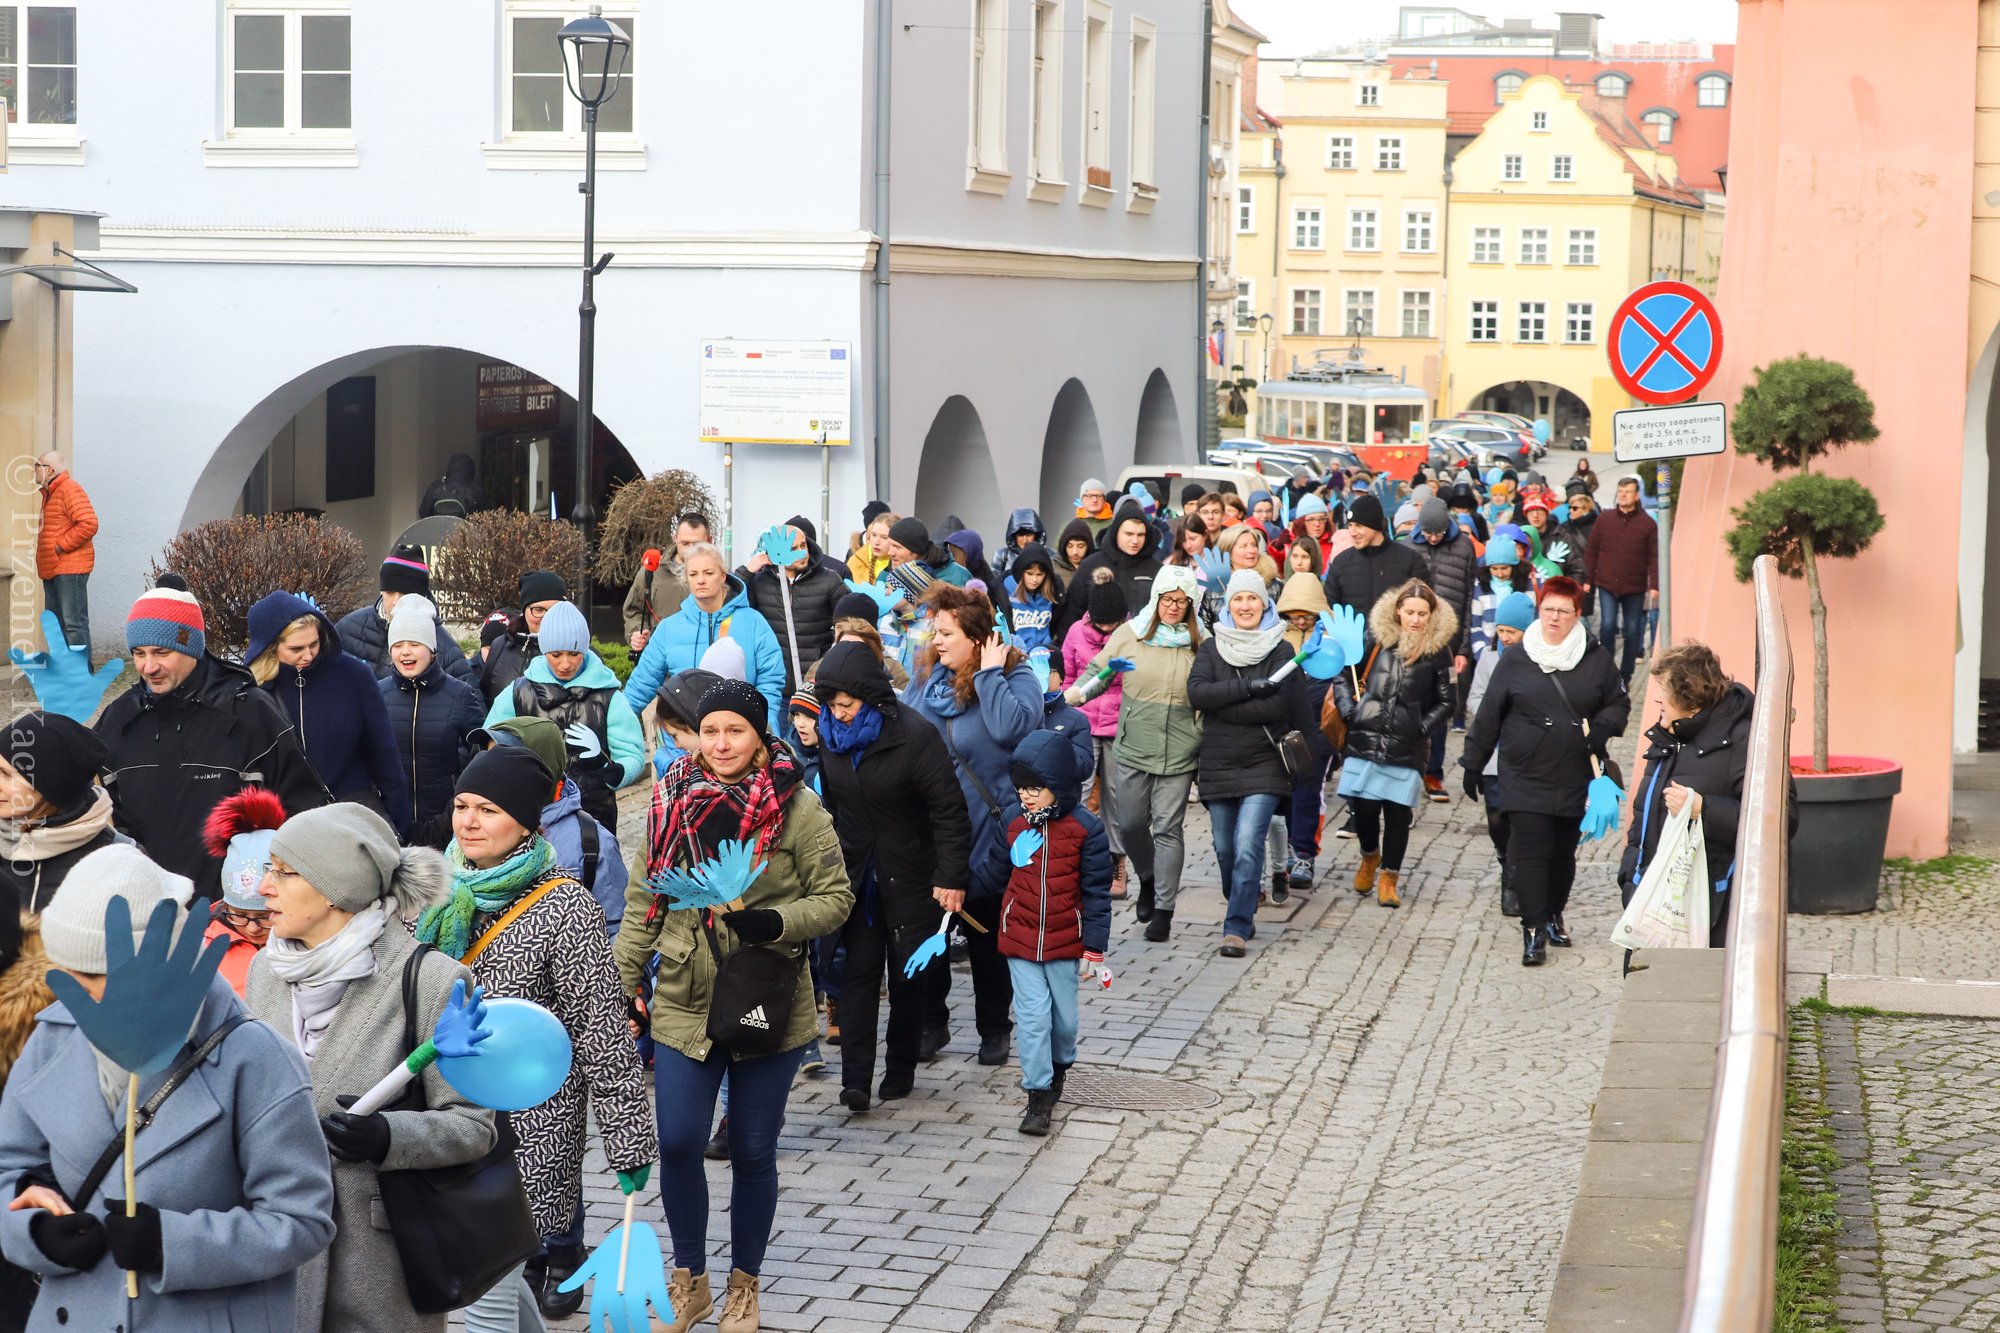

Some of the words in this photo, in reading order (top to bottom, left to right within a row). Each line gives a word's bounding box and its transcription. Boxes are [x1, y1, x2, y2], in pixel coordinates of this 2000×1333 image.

[526, 395, 556, 411] BILETY
[1637, 421, 1667, 430] dotyczy
[1669, 415, 1721, 427] zaopatrzenia
[1643, 431, 1654, 439] do
[1644, 441, 1665, 451] godz.
[1668, 439, 1683, 447] 6-11
[1691, 435, 1712, 444] 17-22
[740, 1017, 770, 1030] adidas
